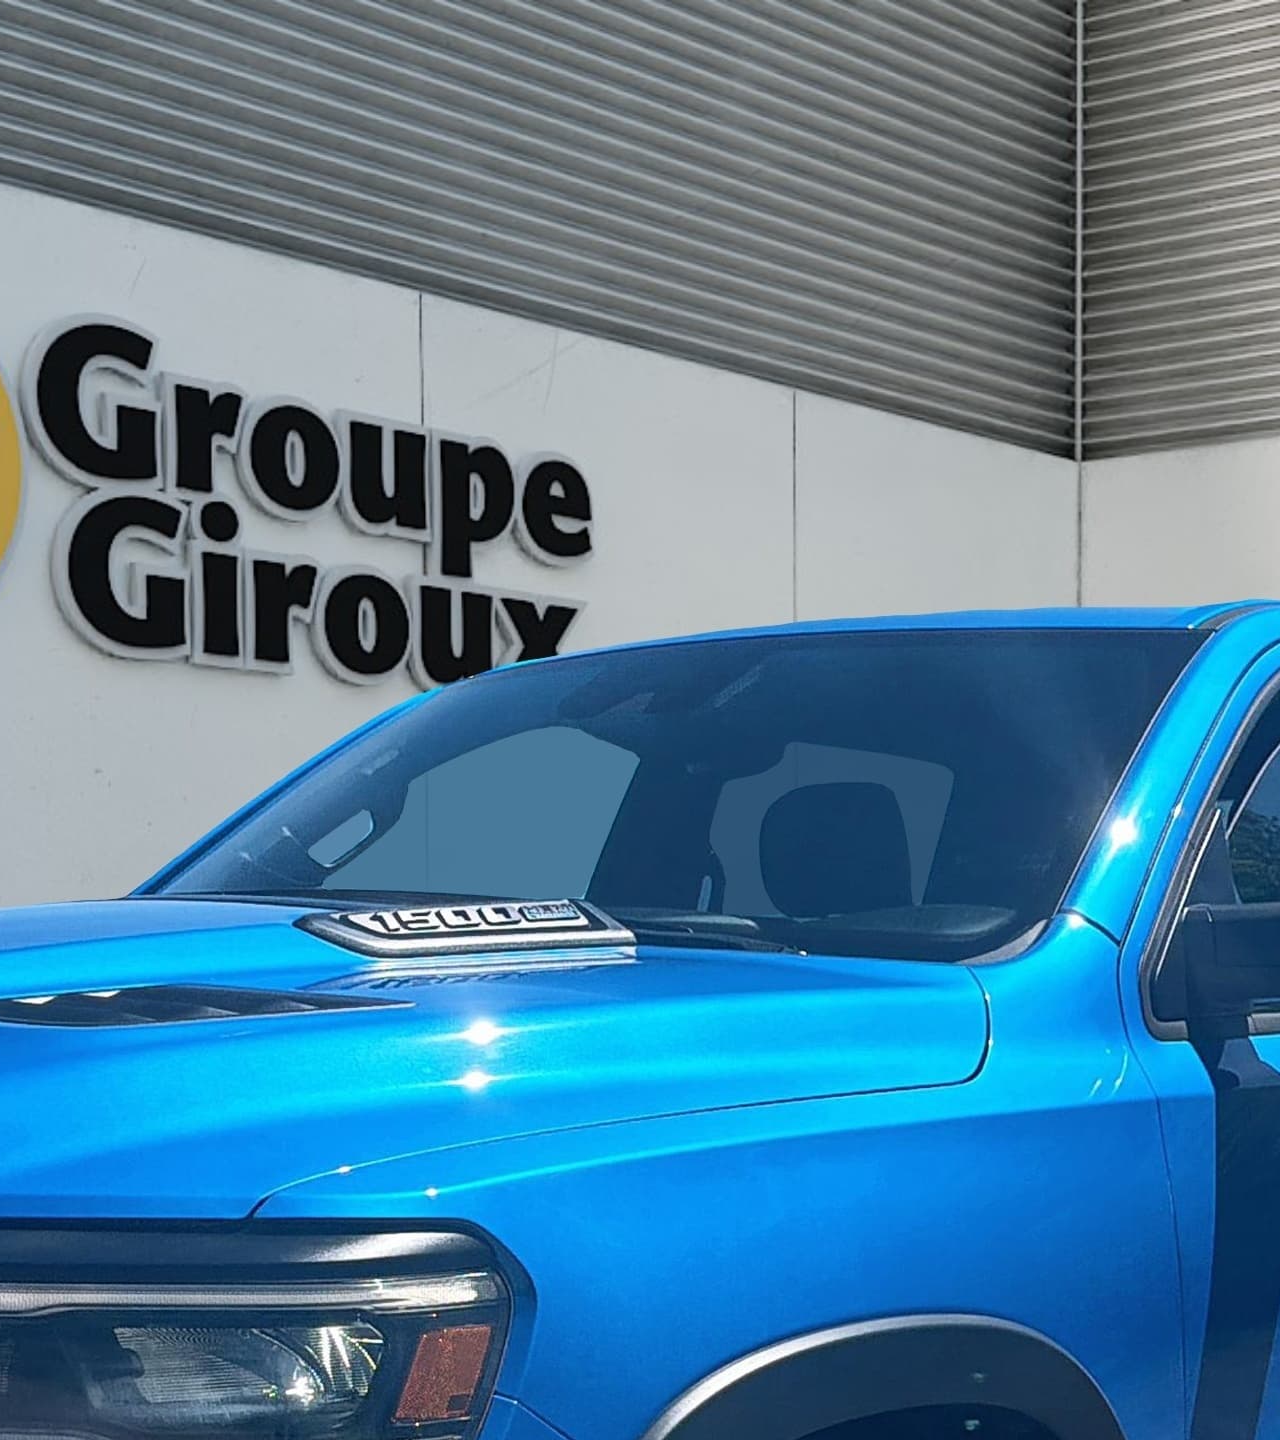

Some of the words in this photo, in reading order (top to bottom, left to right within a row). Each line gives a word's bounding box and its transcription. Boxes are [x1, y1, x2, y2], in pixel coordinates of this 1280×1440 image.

[36, 324, 593, 578] Groupe
[68, 495, 579, 683] Giroux
[369, 904, 523, 932] 1500
